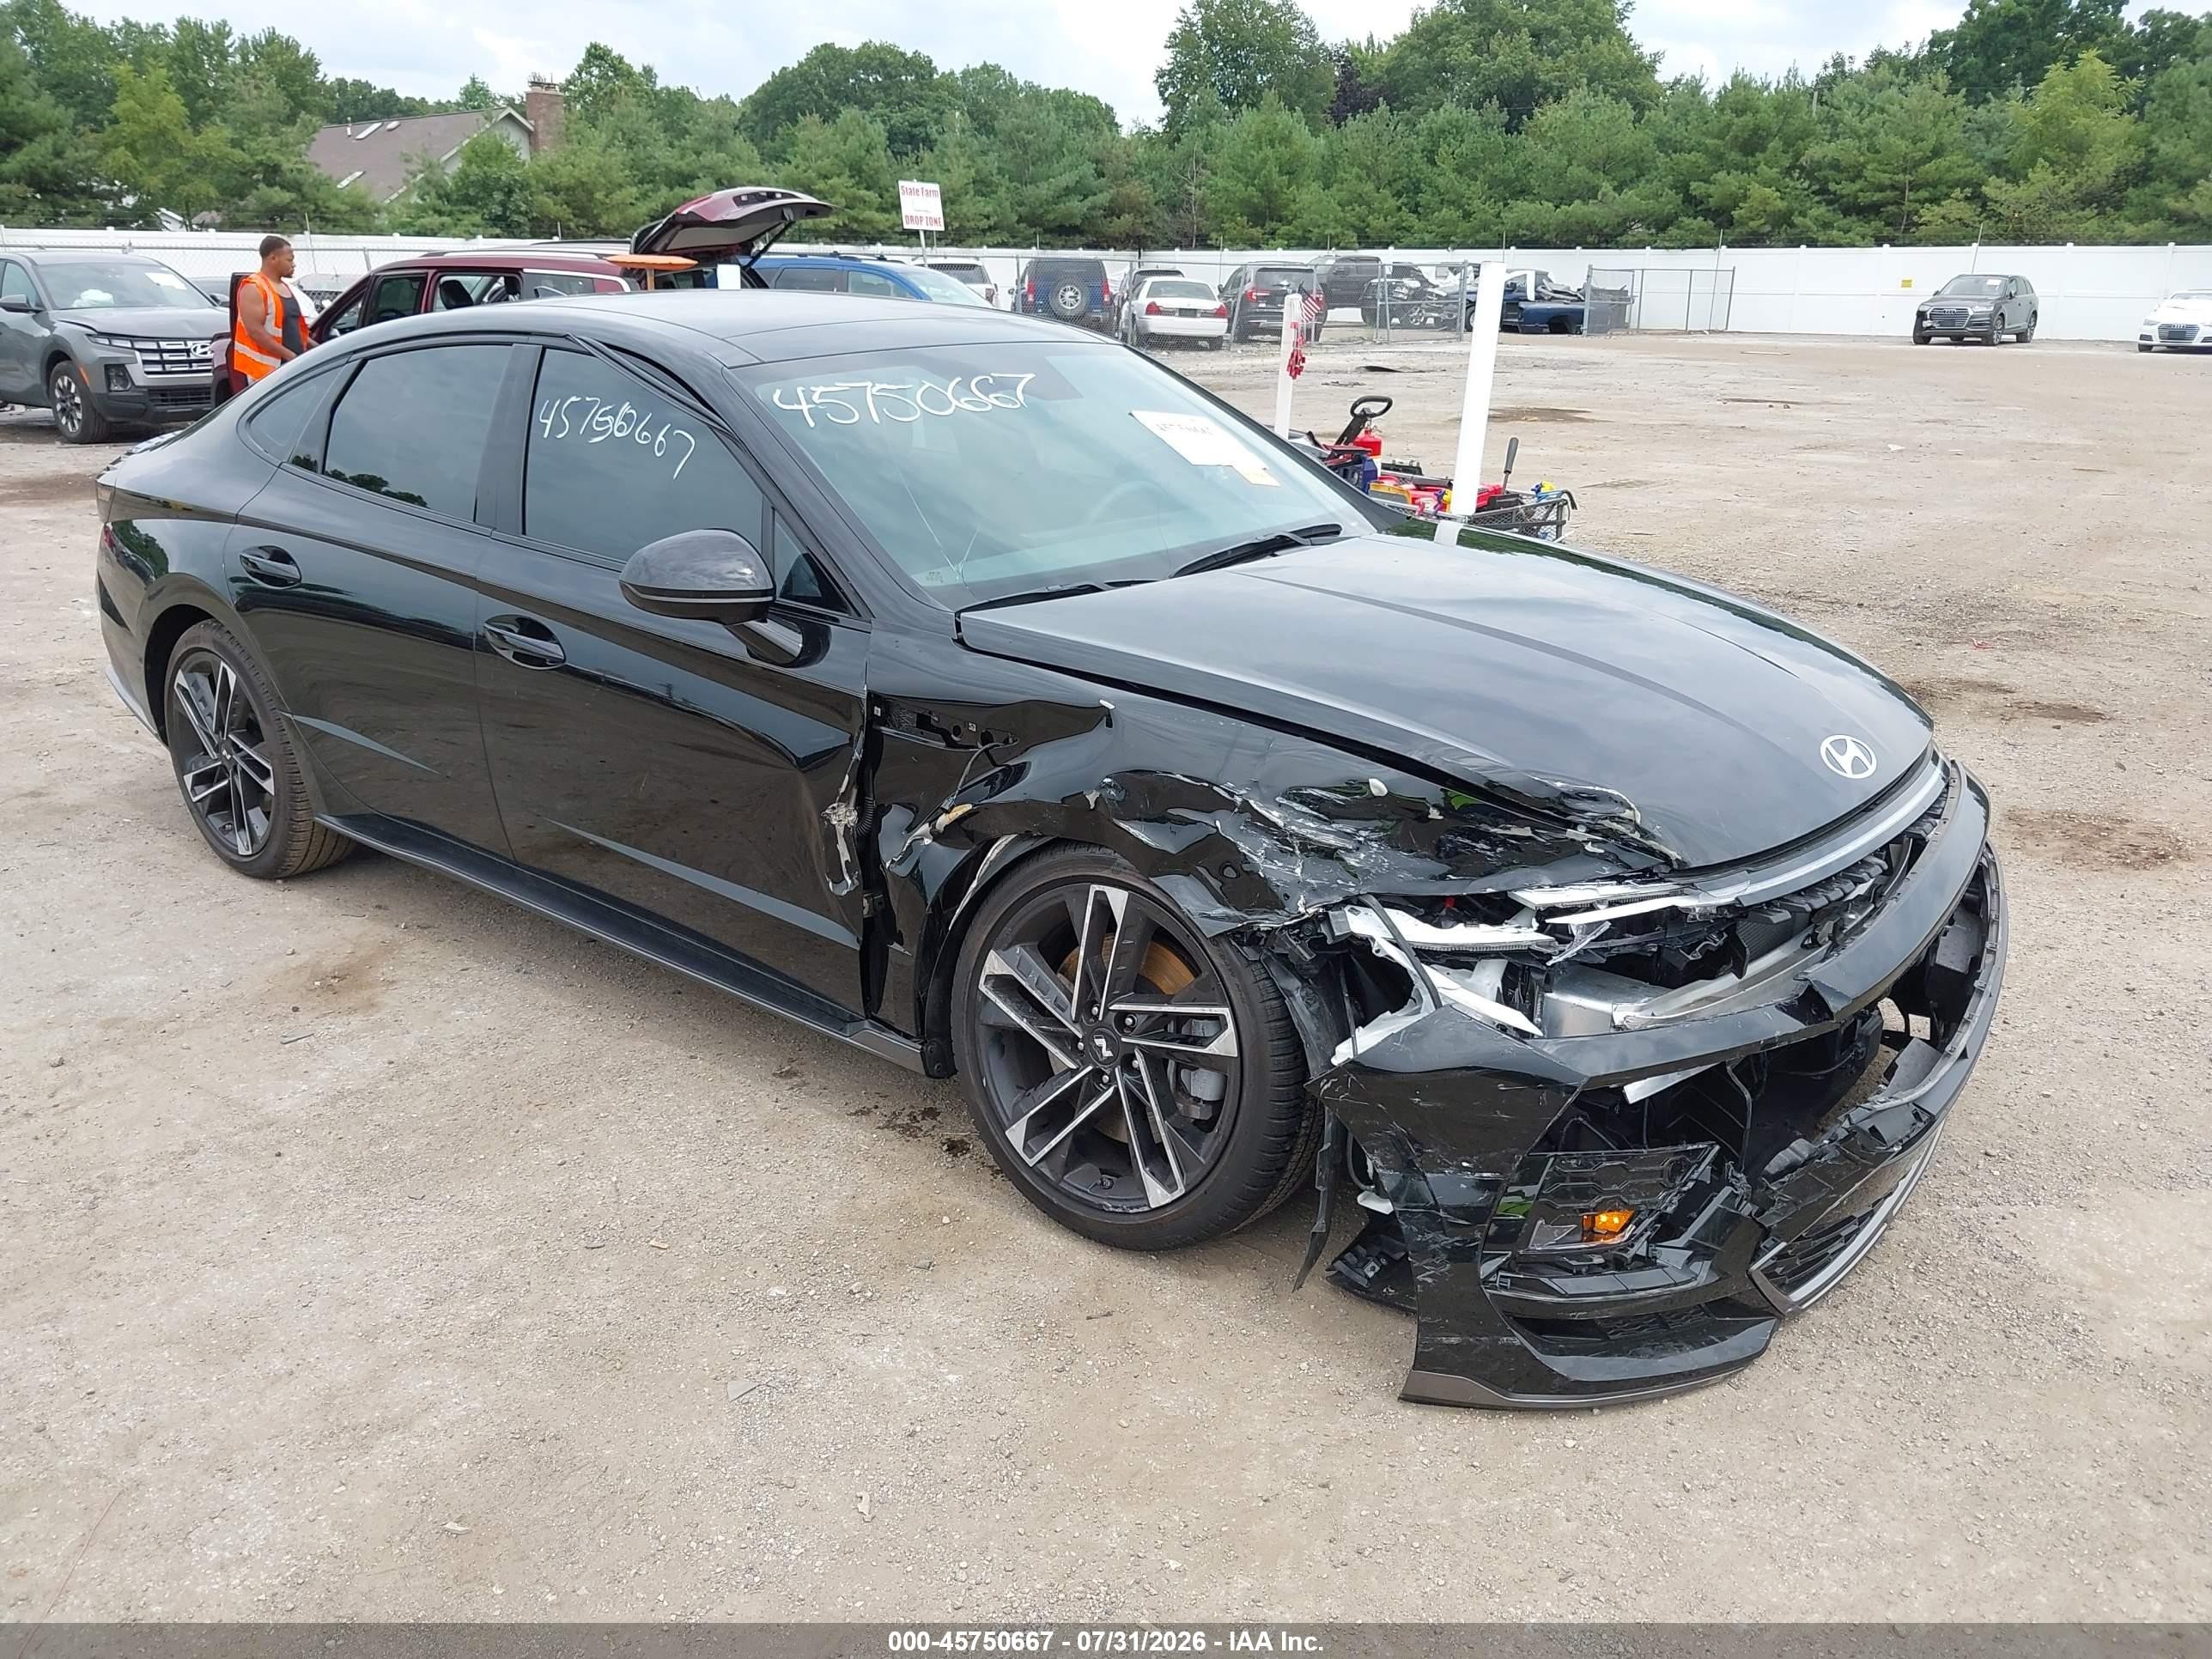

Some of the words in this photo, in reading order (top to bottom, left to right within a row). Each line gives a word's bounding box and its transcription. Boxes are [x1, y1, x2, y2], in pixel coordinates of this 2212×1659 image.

[901, 185, 920, 197] State
[921, 187, 939, 198] Farm
[905, 215, 924, 226] DROP
[926, 216, 942, 227] ZONE
[773, 373, 1036, 428] 45750667
